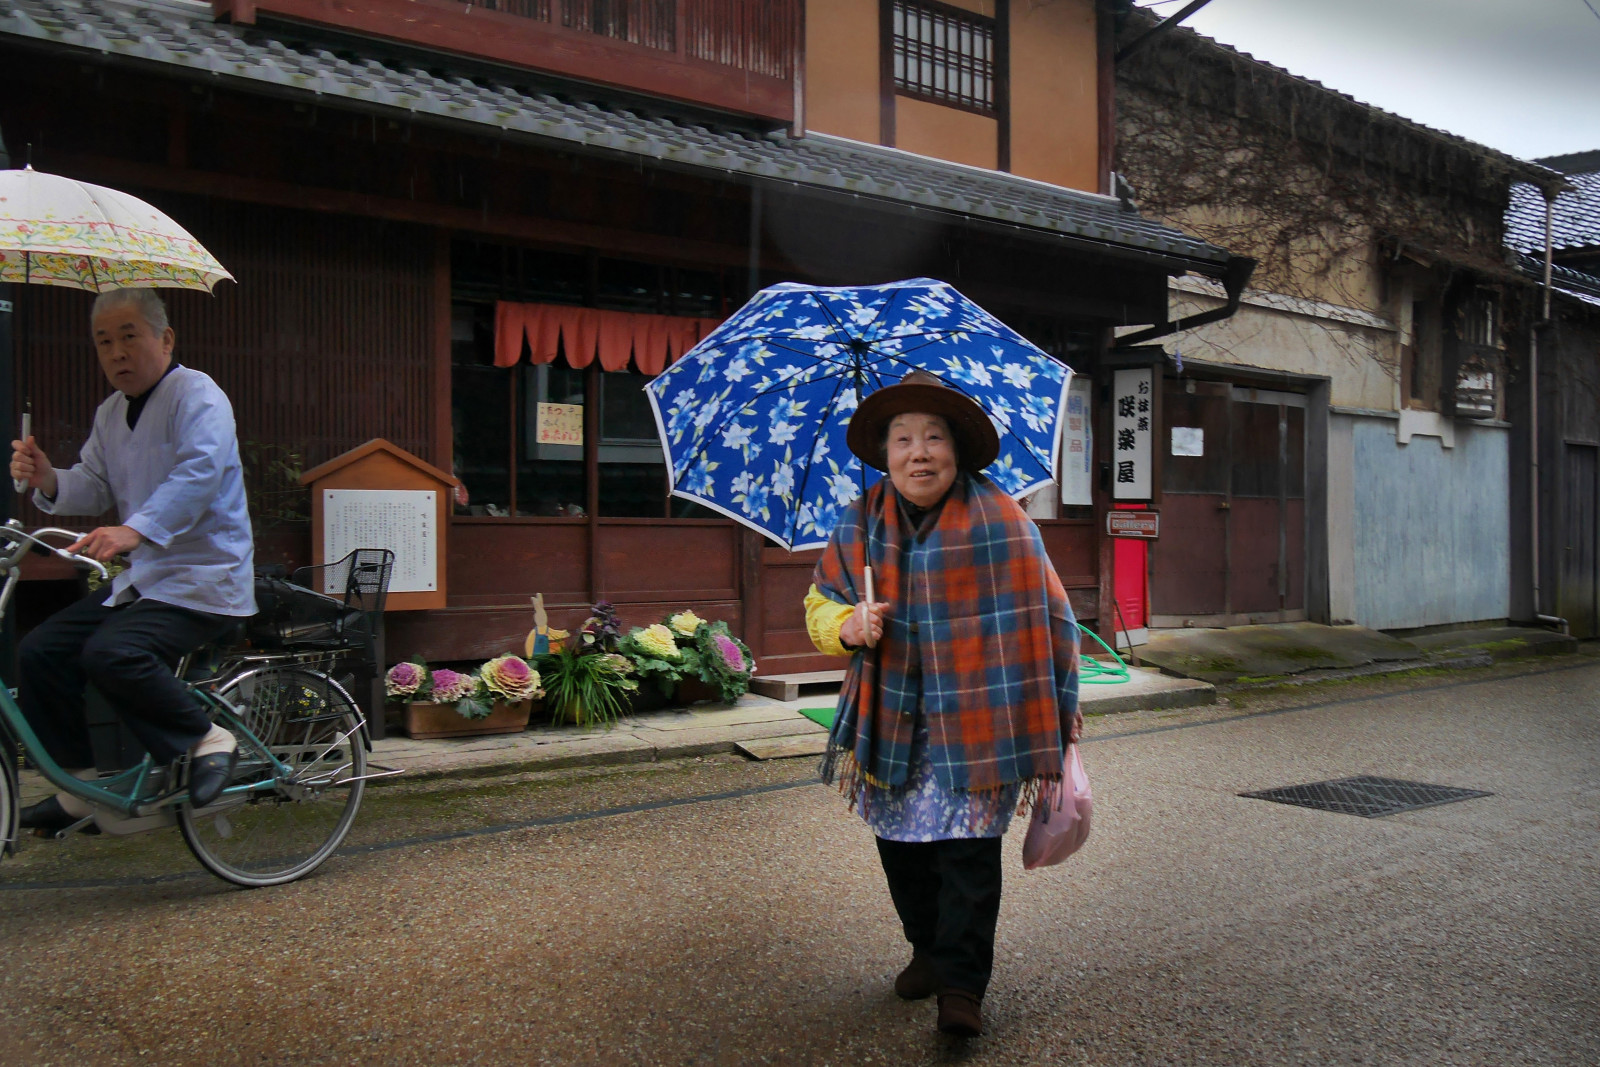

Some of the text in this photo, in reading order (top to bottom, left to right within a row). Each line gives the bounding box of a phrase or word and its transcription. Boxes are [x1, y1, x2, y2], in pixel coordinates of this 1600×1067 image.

[1137, 380, 1149, 431] お抹茶
[1117, 395, 1135, 484] 咲楽屋
[1112, 519, 1155, 531] Gallery
